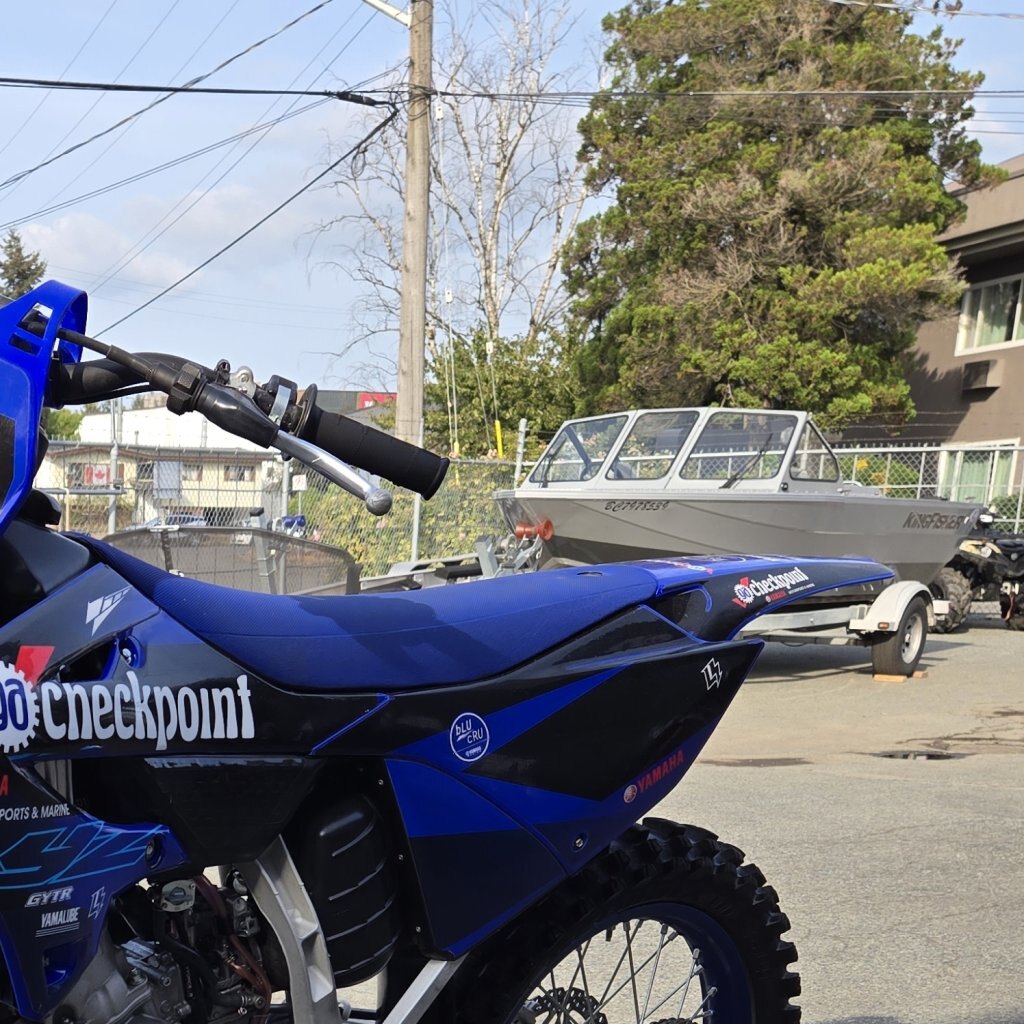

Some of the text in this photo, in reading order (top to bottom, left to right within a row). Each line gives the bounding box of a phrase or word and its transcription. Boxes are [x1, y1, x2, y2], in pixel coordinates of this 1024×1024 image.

[749, 566, 809, 597] checkpoint
[41, 670, 255, 751] checkpoint
[637, 750, 684, 793] YAMAHA
[31, 806, 39, 818] &
[40, 803, 71, 819] MARINE
[24, 885, 74, 908] GYTR
[41, 906, 81, 929] YAMALUBE
